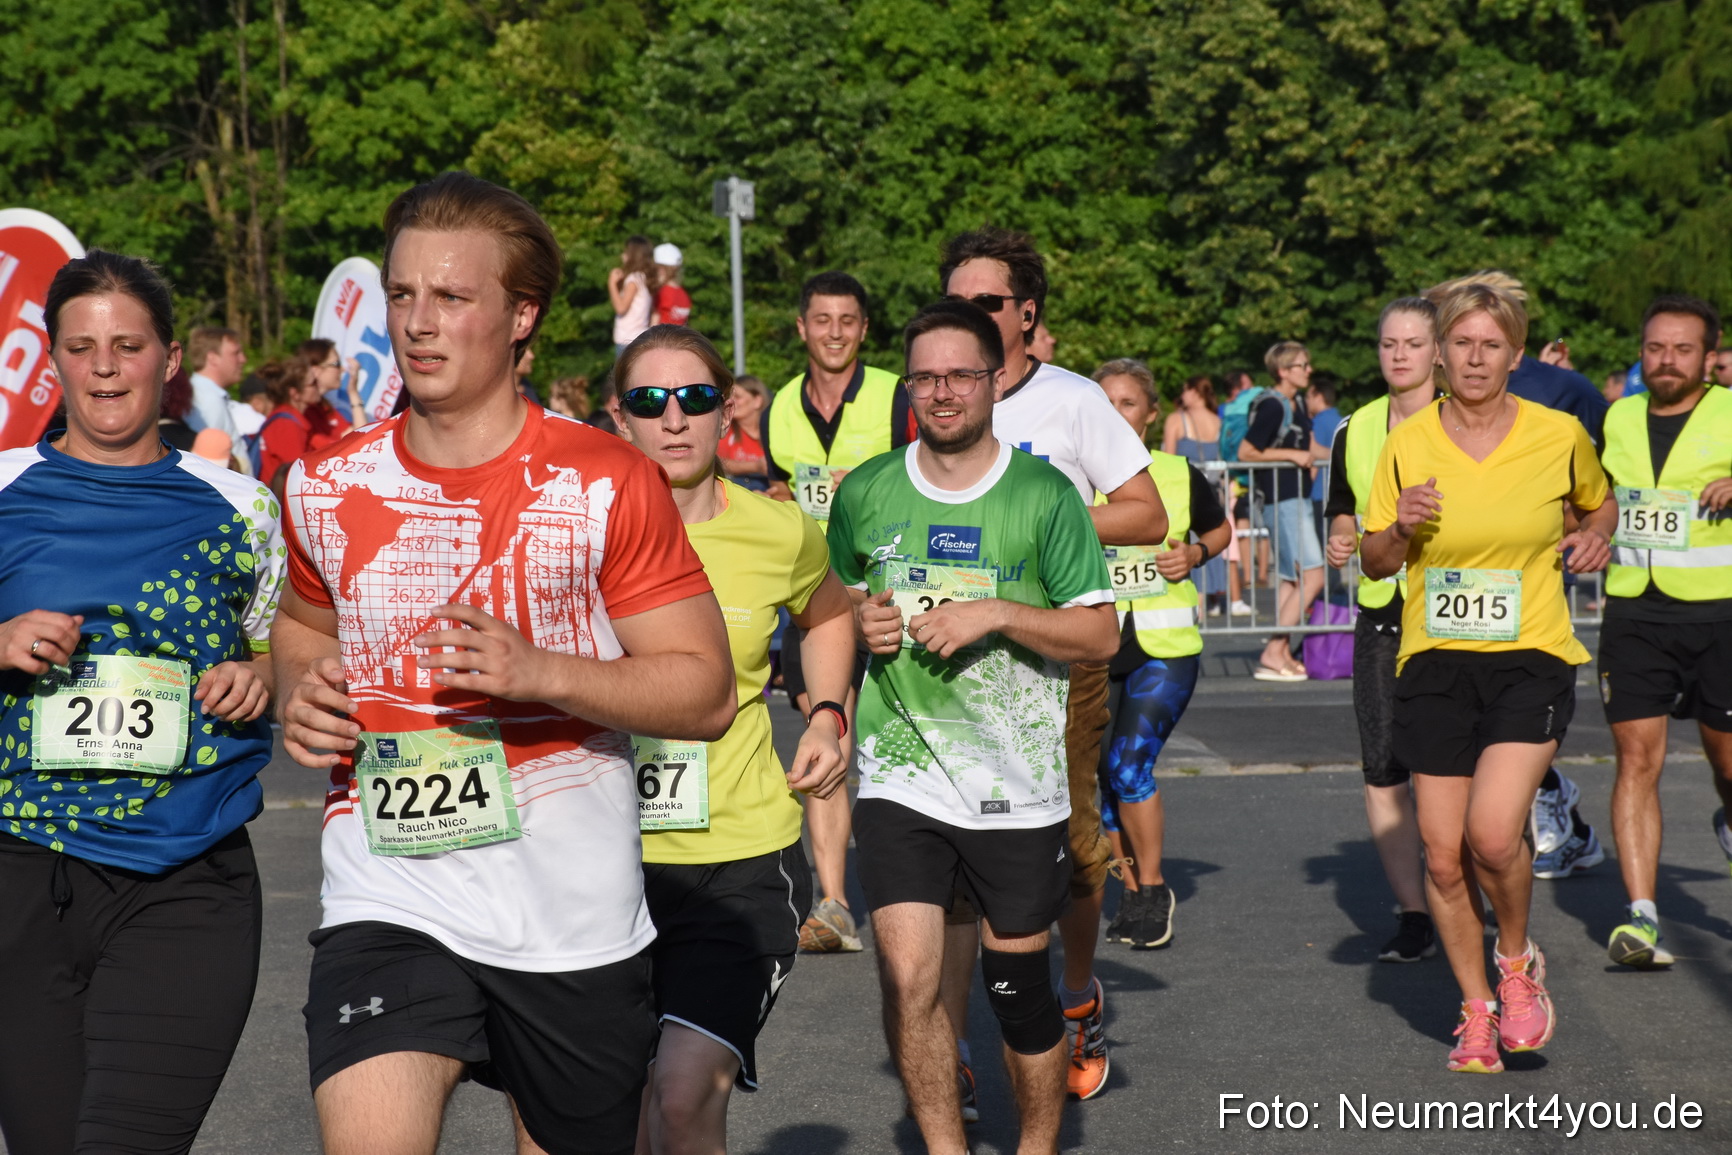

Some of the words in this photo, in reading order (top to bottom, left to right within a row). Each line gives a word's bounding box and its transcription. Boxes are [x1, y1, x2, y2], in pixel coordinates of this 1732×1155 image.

[396, 486, 439, 502] 10.54
[804, 483, 833, 505] 15
[1622, 508, 1678, 532] 1518
[939, 540, 978, 553] Fischer
[388, 588, 437, 604] 26.22
[1435, 593, 1508, 621] 2015
[154, 690, 181, 703] 2019
[64, 696, 154, 740] 203
[76, 738, 107, 750] Erns
[111, 739, 143, 752] Anna
[123, 752, 136, 761] SE
[463, 752, 494, 768] 2019
[672, 752, 698, 761] 2019
[636, 762, 688, 800] 67
[371, 766, 491, 821] 2224
[638, 801, 684, 812] Rebekka
[985, 802, 1002, 811] AOK
[397, 820, 436, 834] Rauch
[438, 816, 468, 831] Nico
[379, 833, 414, 845] Sparkasse
[415, 822, 498, 843] Neumarkt-Parsberg
